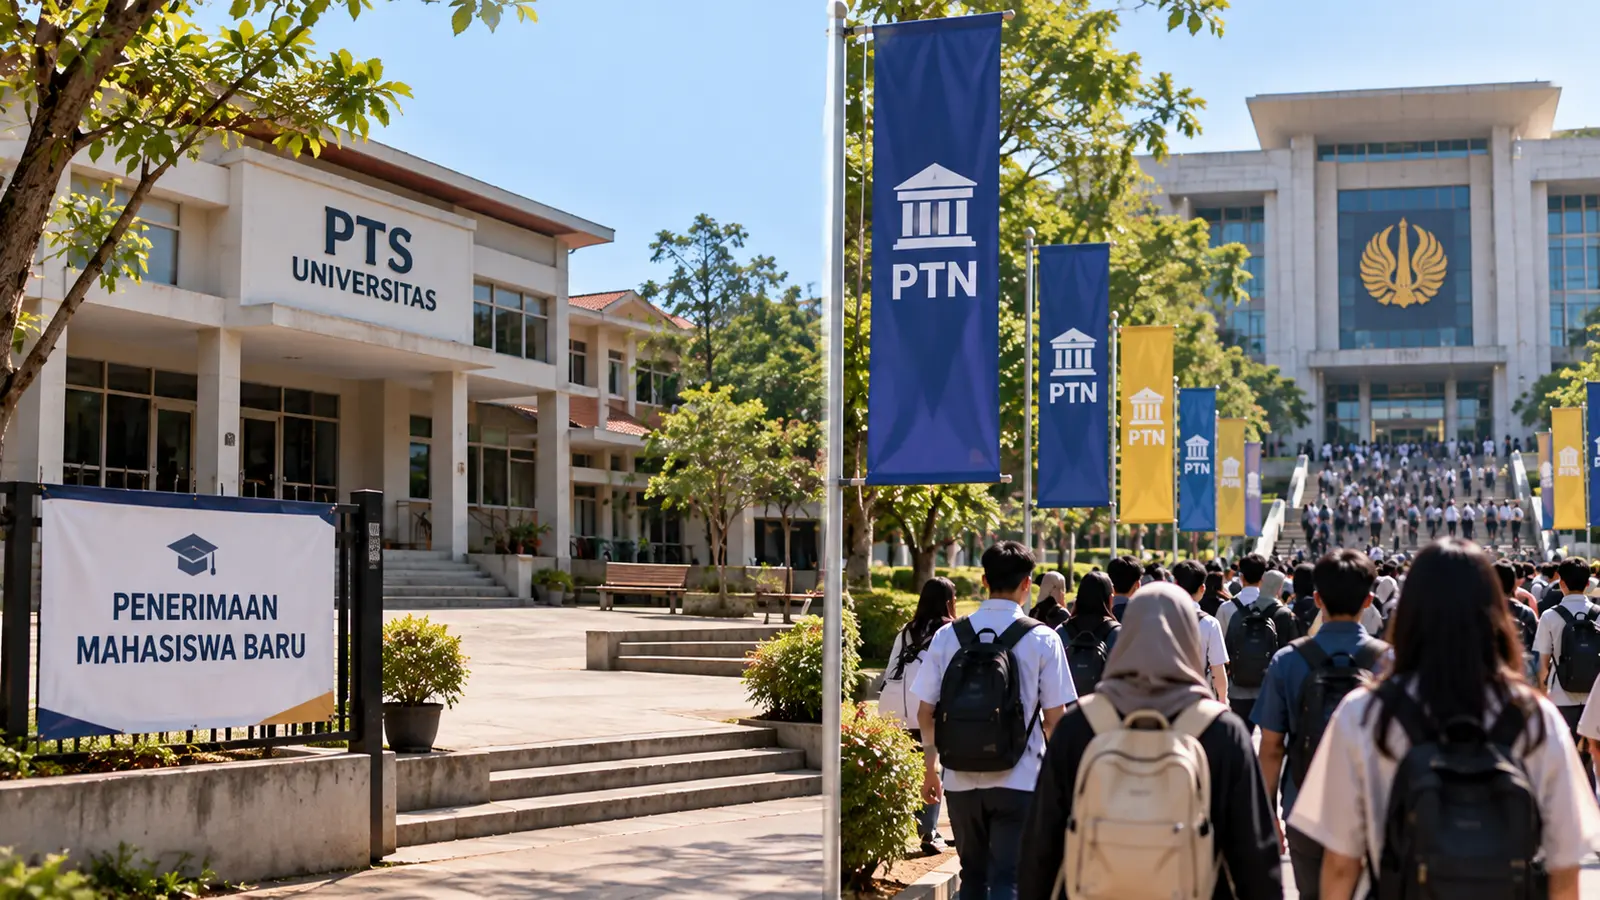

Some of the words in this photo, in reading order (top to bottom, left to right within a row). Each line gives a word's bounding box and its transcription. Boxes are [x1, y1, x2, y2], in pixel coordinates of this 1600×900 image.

[324, 206, 413, 274] PTS
[292, 256, 437, 312] UNIVERSITAS
[892, 261, 977, 300] PTN
[1049, 382, 1097, 404] PTN
[1128, 429, 1165, 446] PTN
[1184, 462, 1210, 475] PTN
[113, 592, 278, 621] PENERIMAAN
[76, 634, 237, 665] MAHASISWA
[243, 633, 306, 660] BARU
